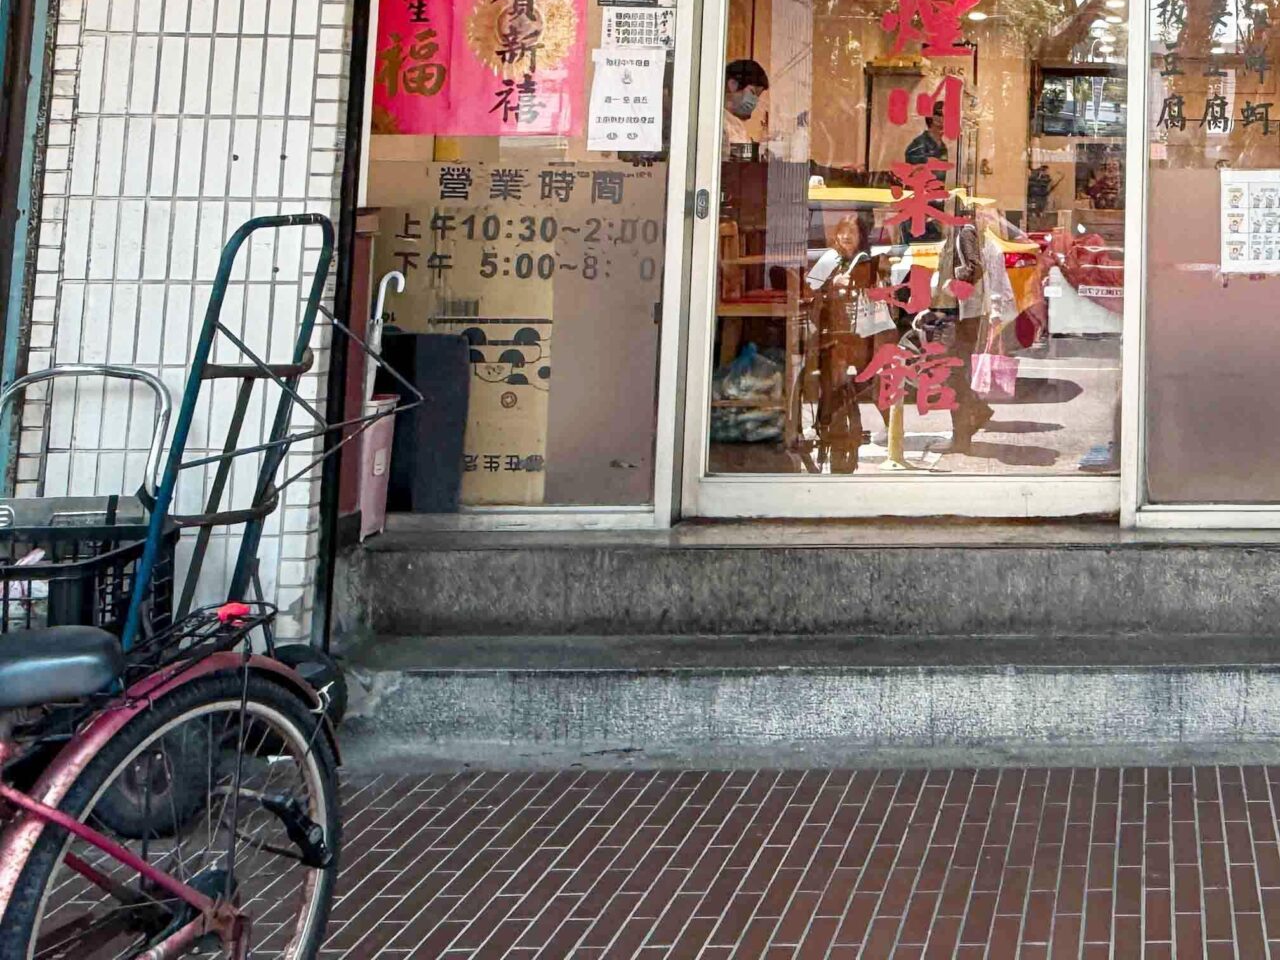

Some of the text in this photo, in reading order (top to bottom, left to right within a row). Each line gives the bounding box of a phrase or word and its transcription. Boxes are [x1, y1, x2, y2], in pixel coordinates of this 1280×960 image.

[440, 167, 625, 204] 營業時間
[394, 251, 656, 280] 下午 5:00~8:0
[465, 454, 543, 472] 在生活
